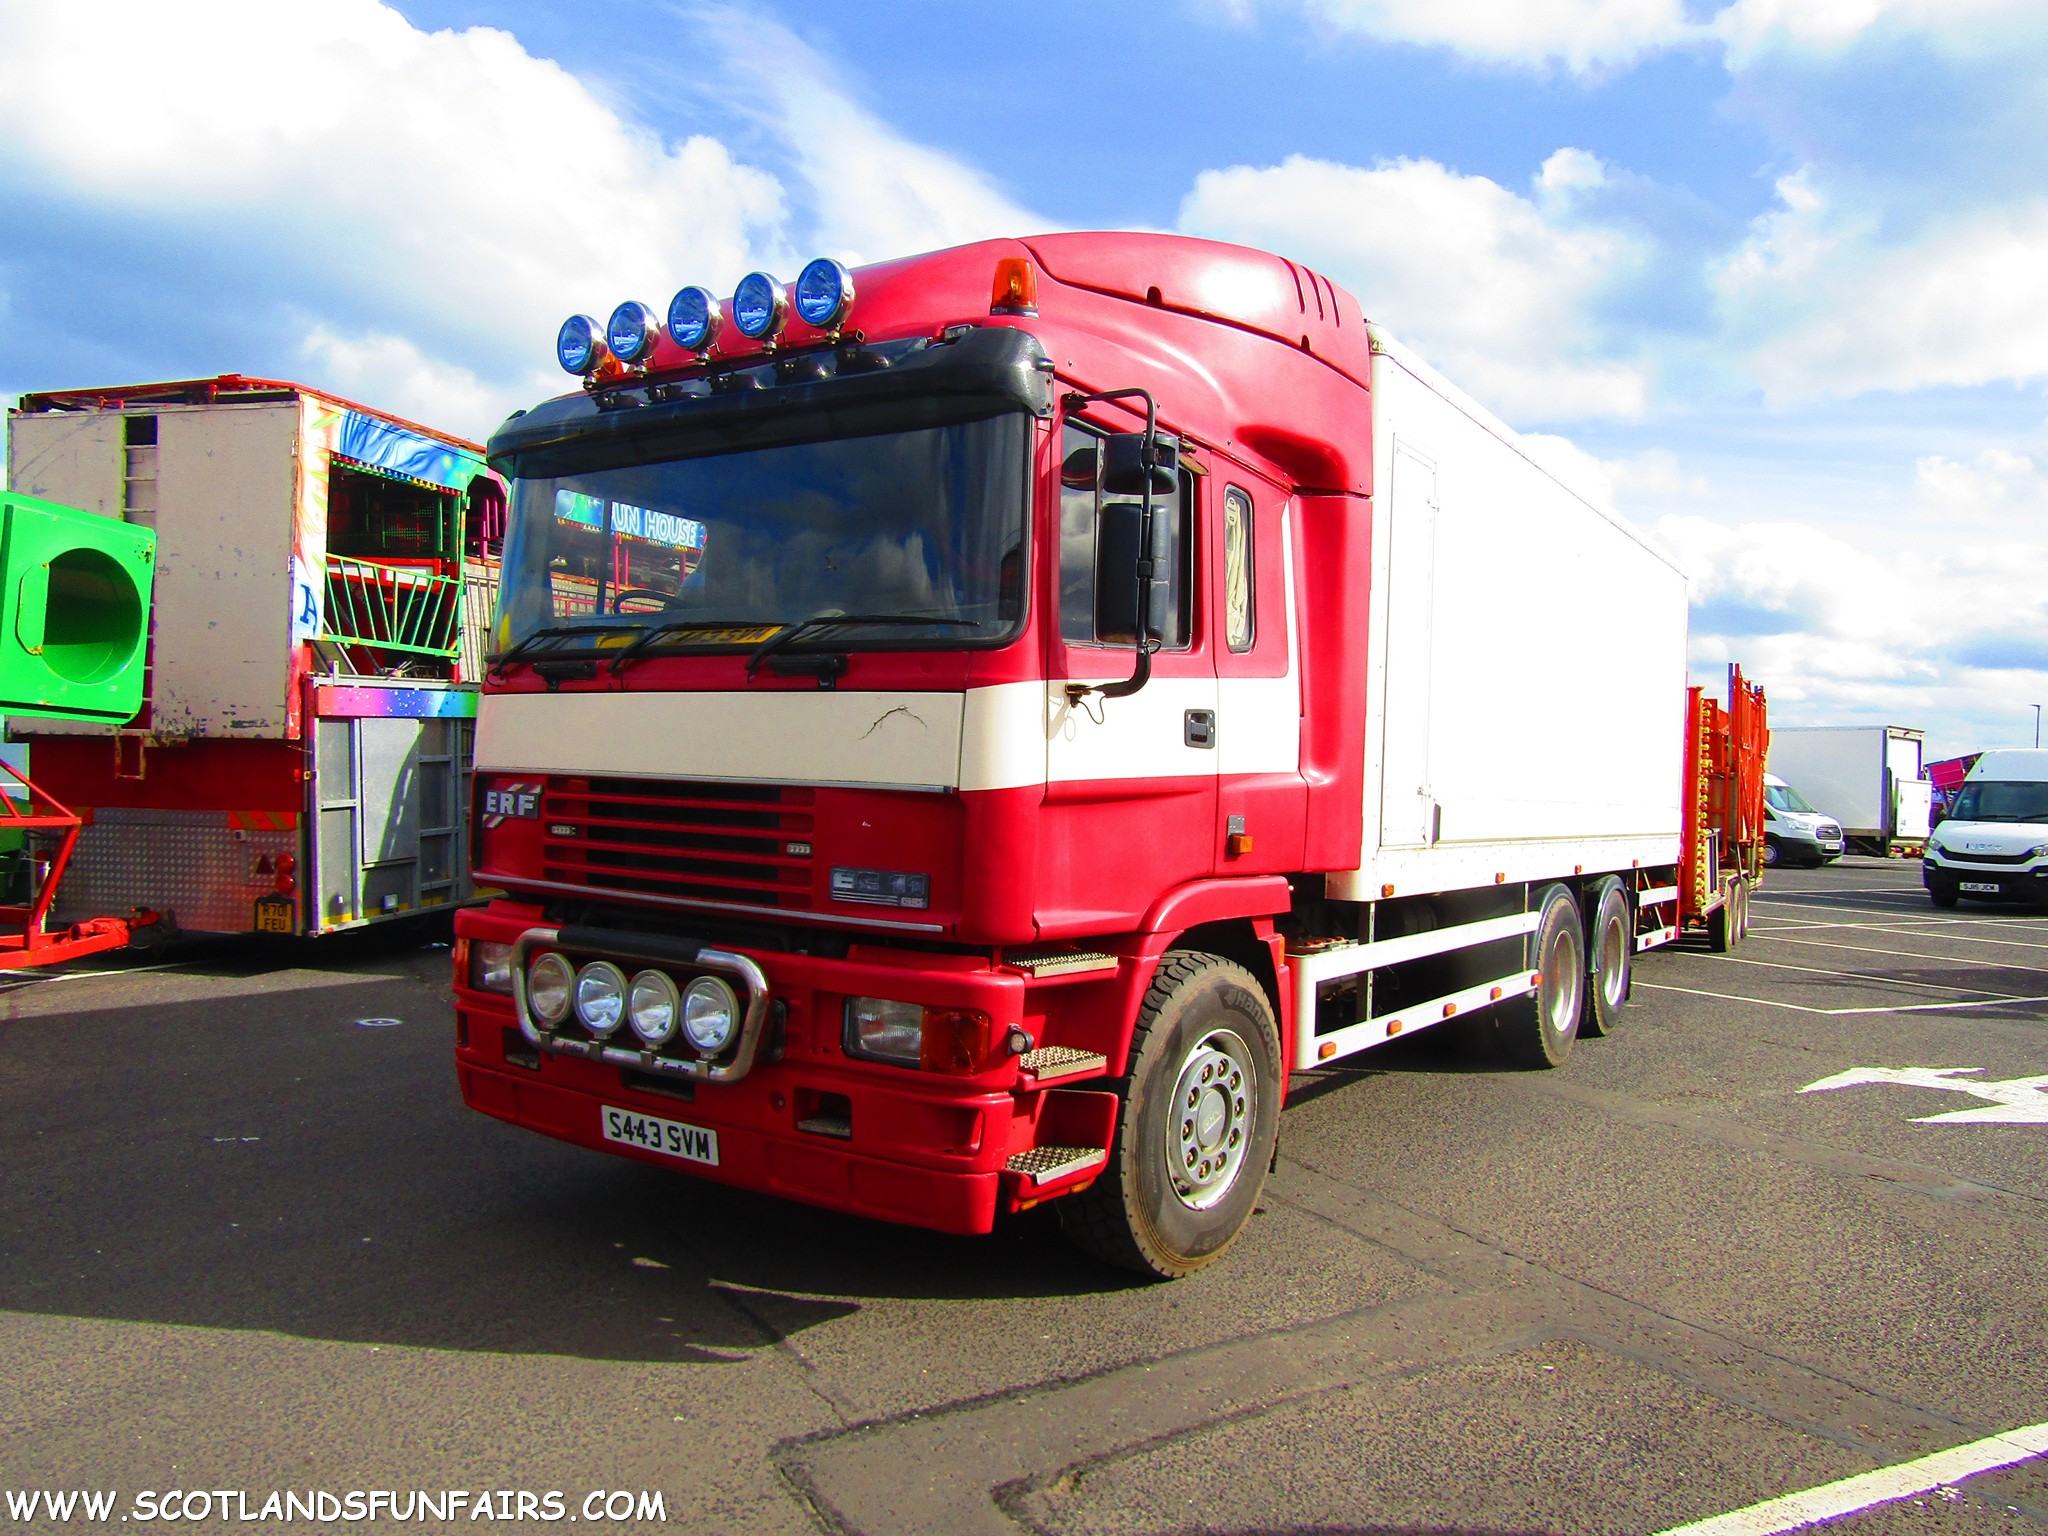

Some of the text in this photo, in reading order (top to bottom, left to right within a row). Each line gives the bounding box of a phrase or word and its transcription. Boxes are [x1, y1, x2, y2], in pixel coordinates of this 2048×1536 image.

[612, 502, 697, 547] UN HOUSE
[486, 791, 535, 816] ERF
[1966, 843, 2002, 851] IVECO
[264, 918, 286, 930] FEU
[609, 1111, 710, 1160] S443 SVM
